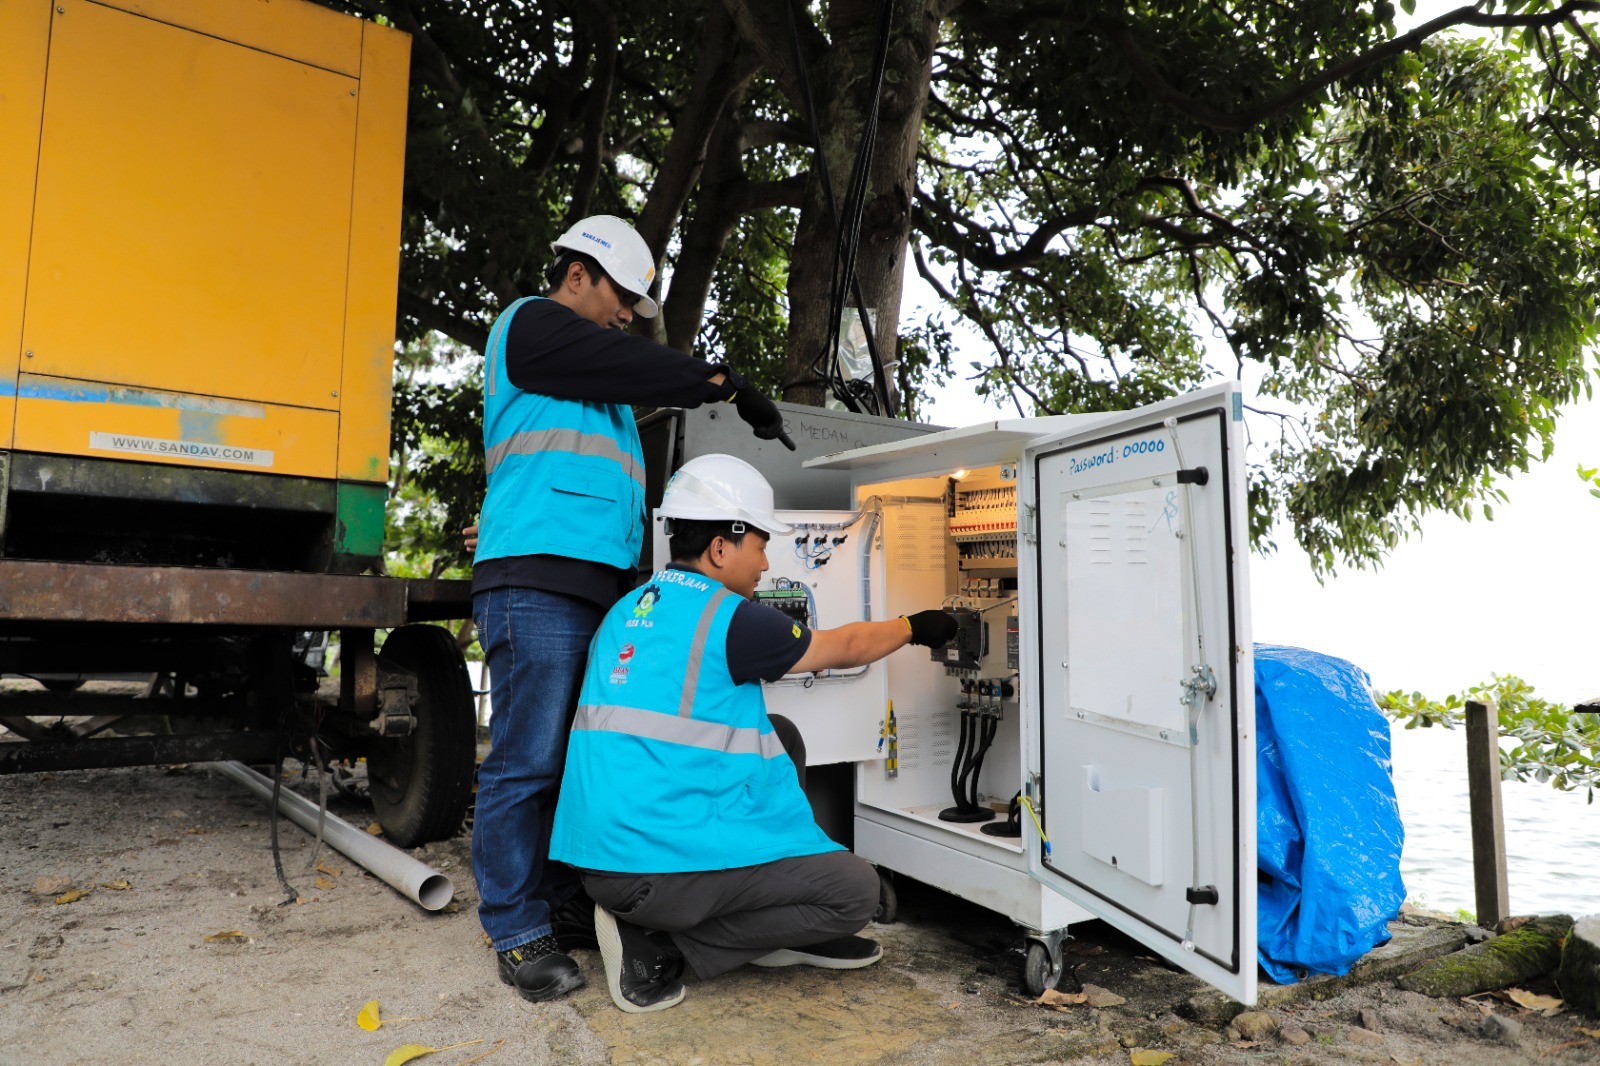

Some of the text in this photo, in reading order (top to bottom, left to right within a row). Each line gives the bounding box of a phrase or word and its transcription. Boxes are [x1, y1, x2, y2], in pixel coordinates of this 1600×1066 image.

[800, 420, 849, 443] MEDAN
[112, 436, 254, 461] WWW.SANDAV.COM
[656, 570, 709, 591] PEKERJAAN
